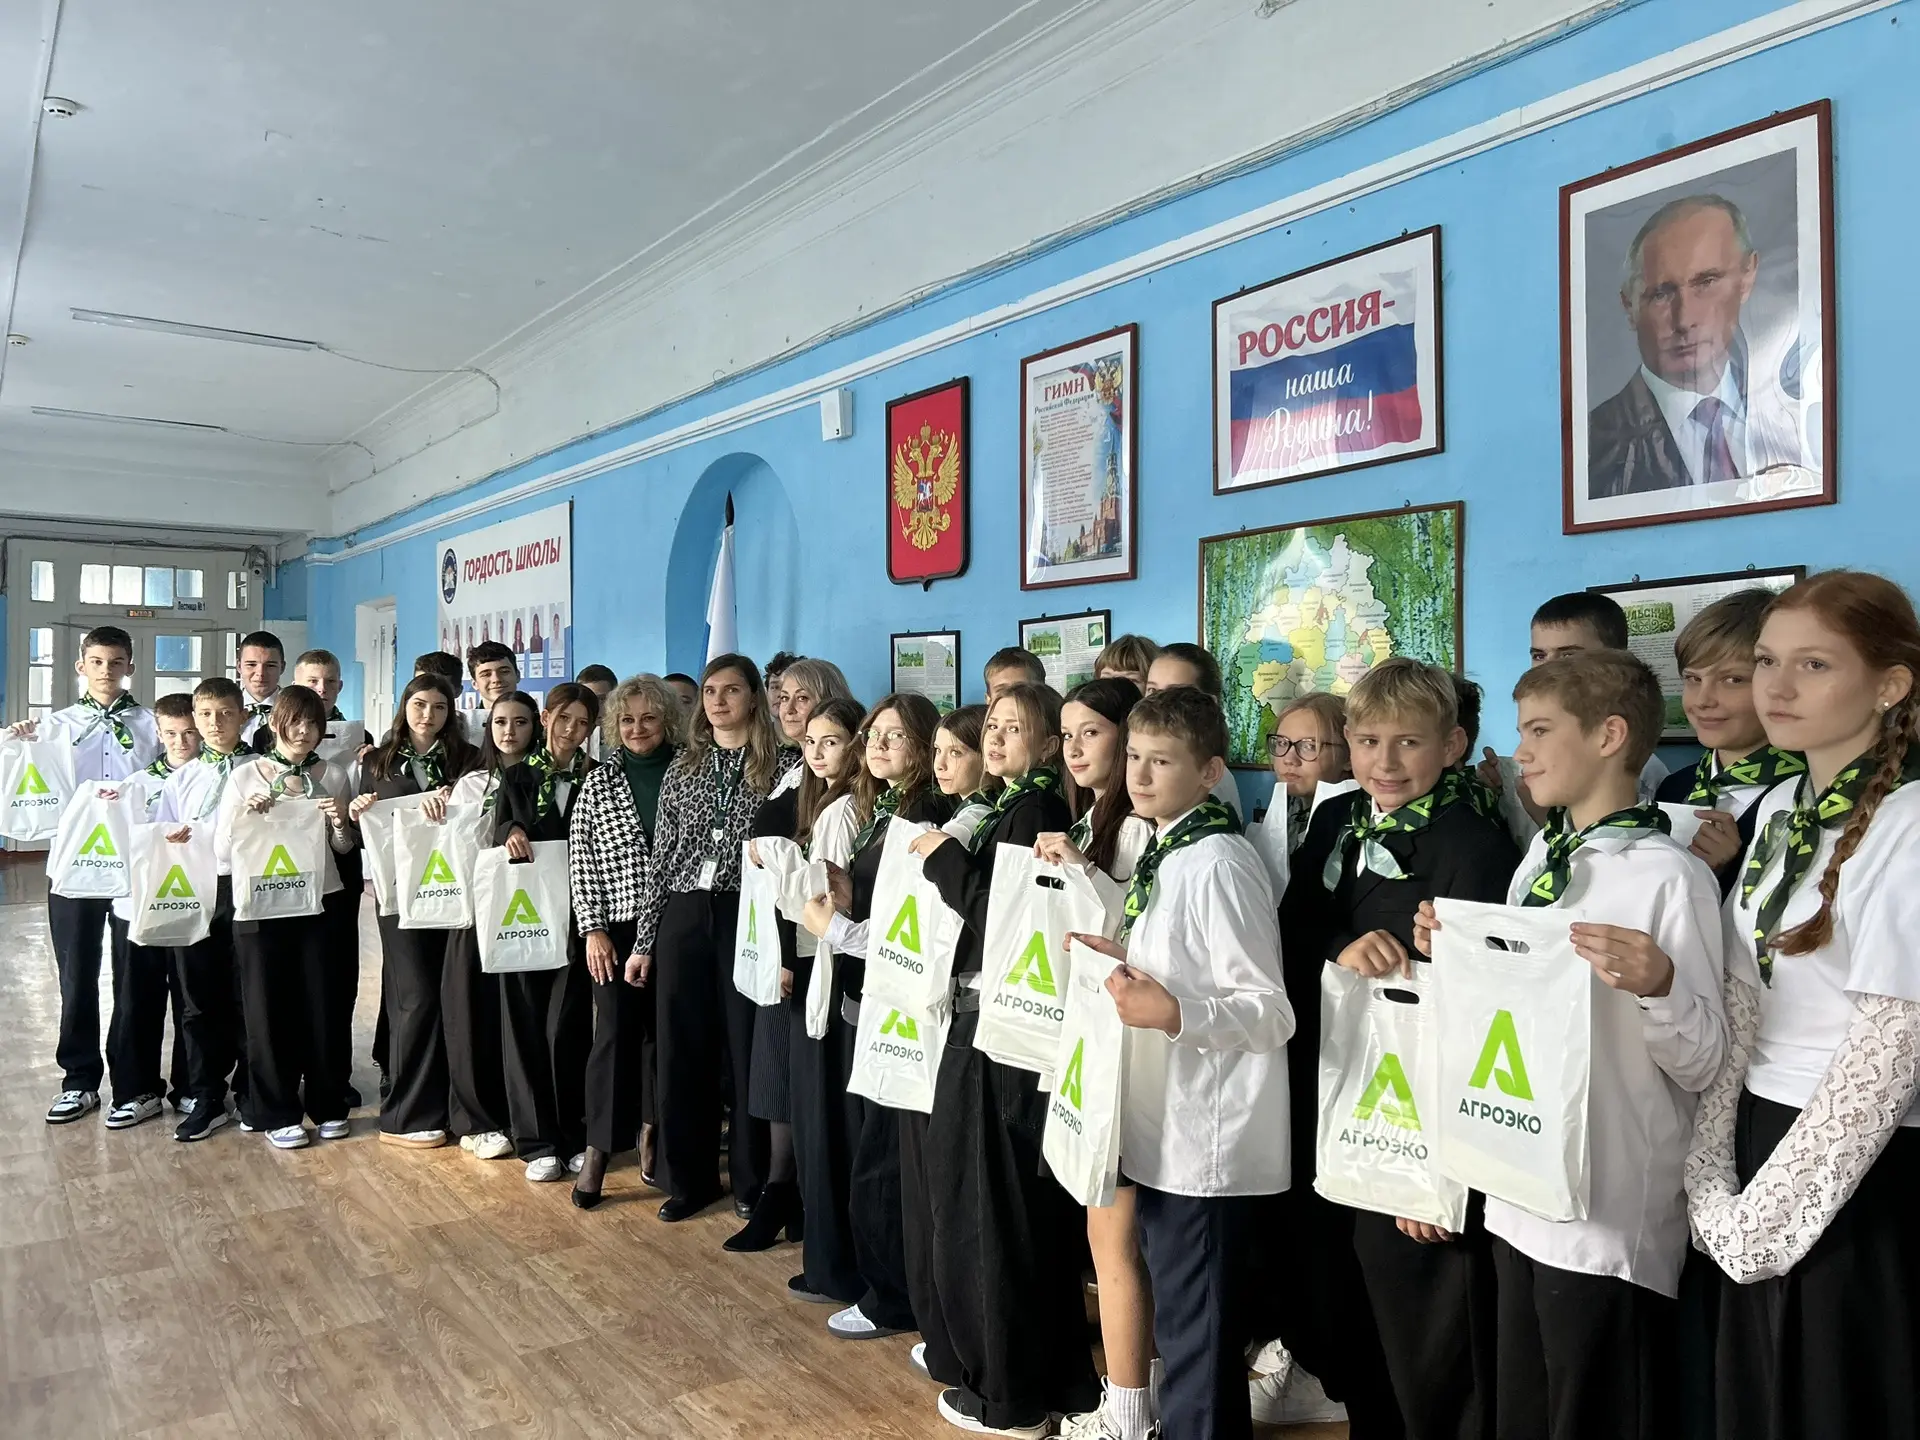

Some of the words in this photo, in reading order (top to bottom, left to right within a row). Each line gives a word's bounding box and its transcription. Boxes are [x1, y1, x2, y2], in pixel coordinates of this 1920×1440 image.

[1237, 289, 1396, 366] РОССИЯ-
[1044, 376, 1085, 402] ГИМН
[1285, 363, 1355, 400] наша
[1262, 389, 1373, 462] Родина!
[463, 549, 513, 585] ГОРДОСТЬ
[515, 536, 562, 571] ШКОЛЫ
[10, 797, 59, 808] АГРОЭКО
[72, 859, 125, 869] АГРОЭКО
[254, 880, 307, 893] АГРОЭКО
[415, 887, 463, 899] АГРОЭКО
[148, 901, 201, 911] АГРОЭКО
[496, 928, 550, 941] АГРОЭКО
[877, 946, 924, 975] АГРОЭКО
[993, 992, 1064, 1023] АГРОЭКО
[869, 1040, 924, 1062] АГРОЭКО
[1052, 1100, 1083, 1136] АГРОЭКО
[1458, 1097, 1542, 1135] АГРОЭКО
[1338, 1127, 1429, 1161] АГРОЭКО
